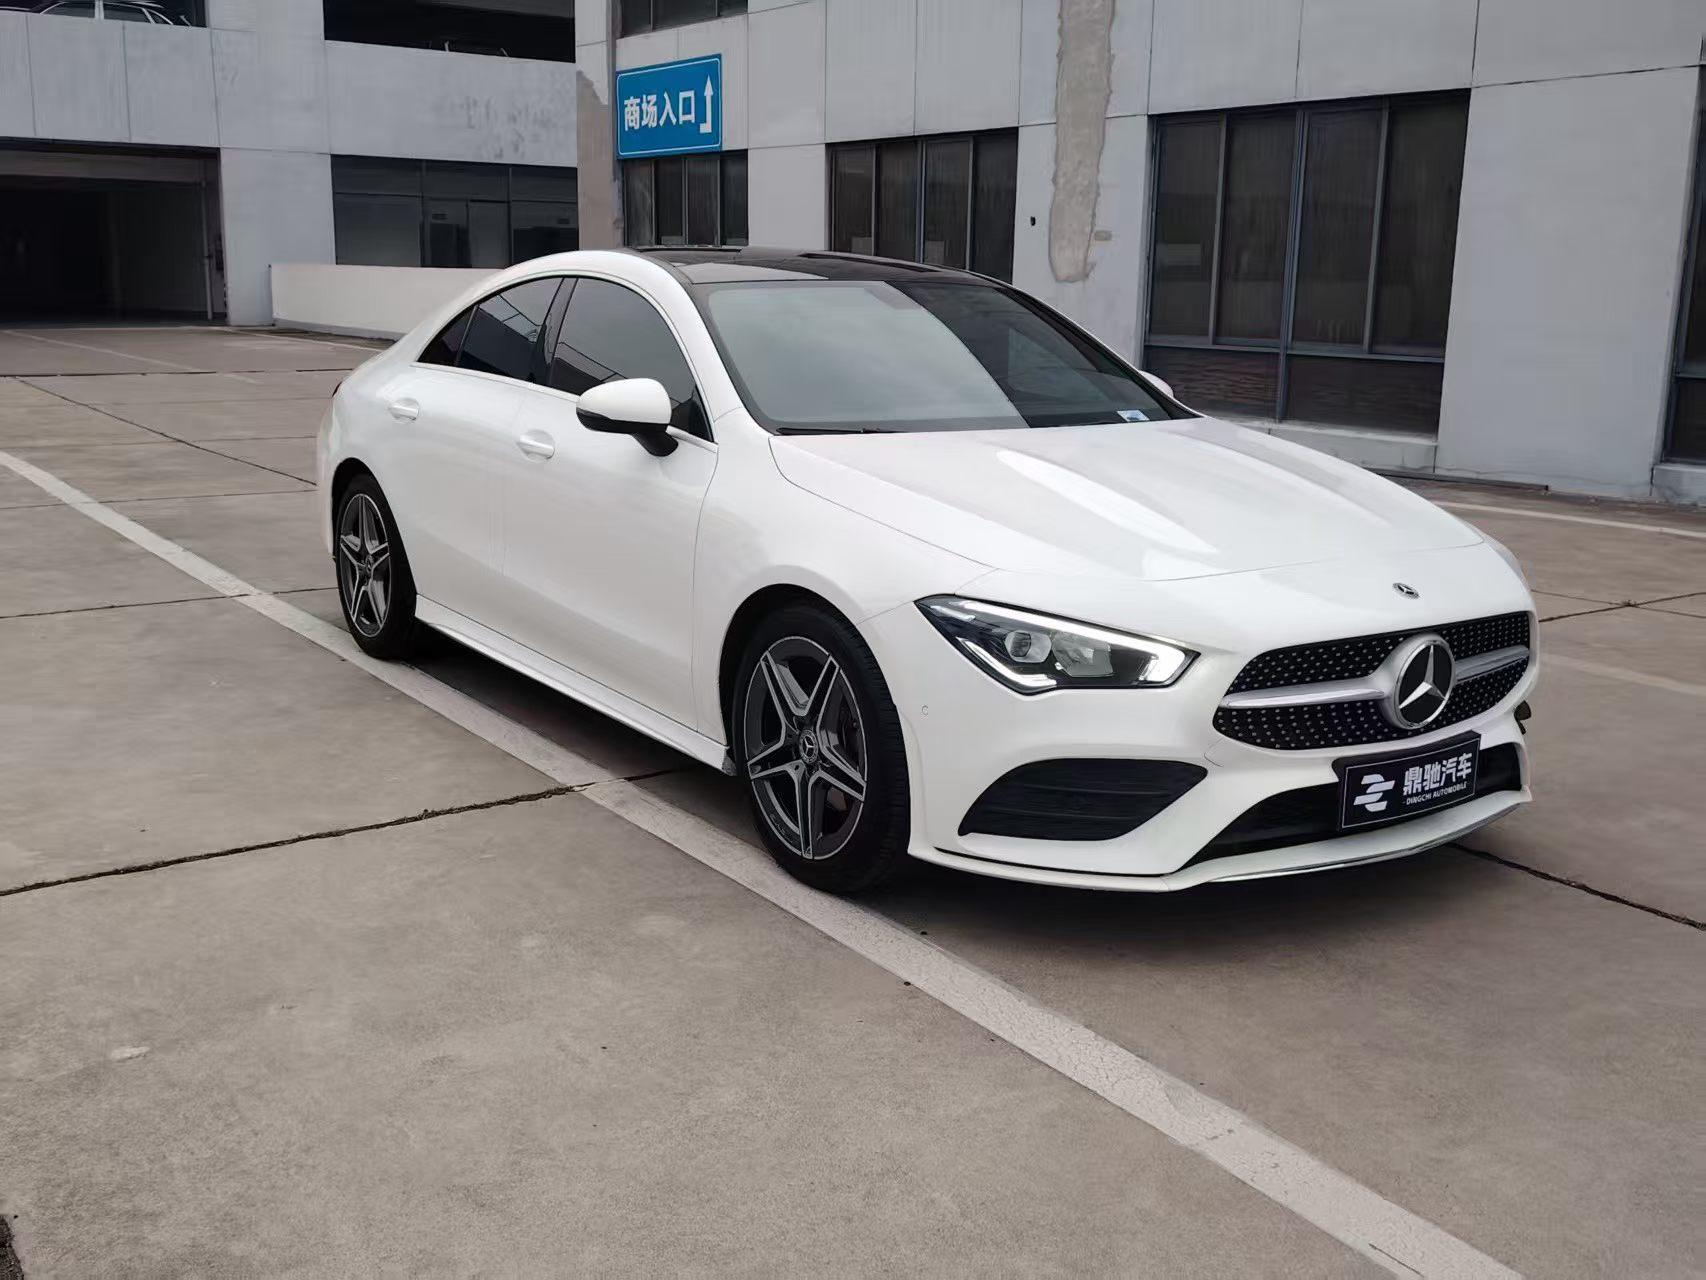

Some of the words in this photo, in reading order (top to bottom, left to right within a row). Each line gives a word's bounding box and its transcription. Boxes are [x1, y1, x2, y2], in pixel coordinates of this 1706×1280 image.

[624, 90, 695, 131] 商场入口
[1403, 752, 1472, 795] 鼎驰汽车
[1406, 792, 1432, 805] DINGCHI
[1433, 782, 1467, 798] AUTOMOBILE
